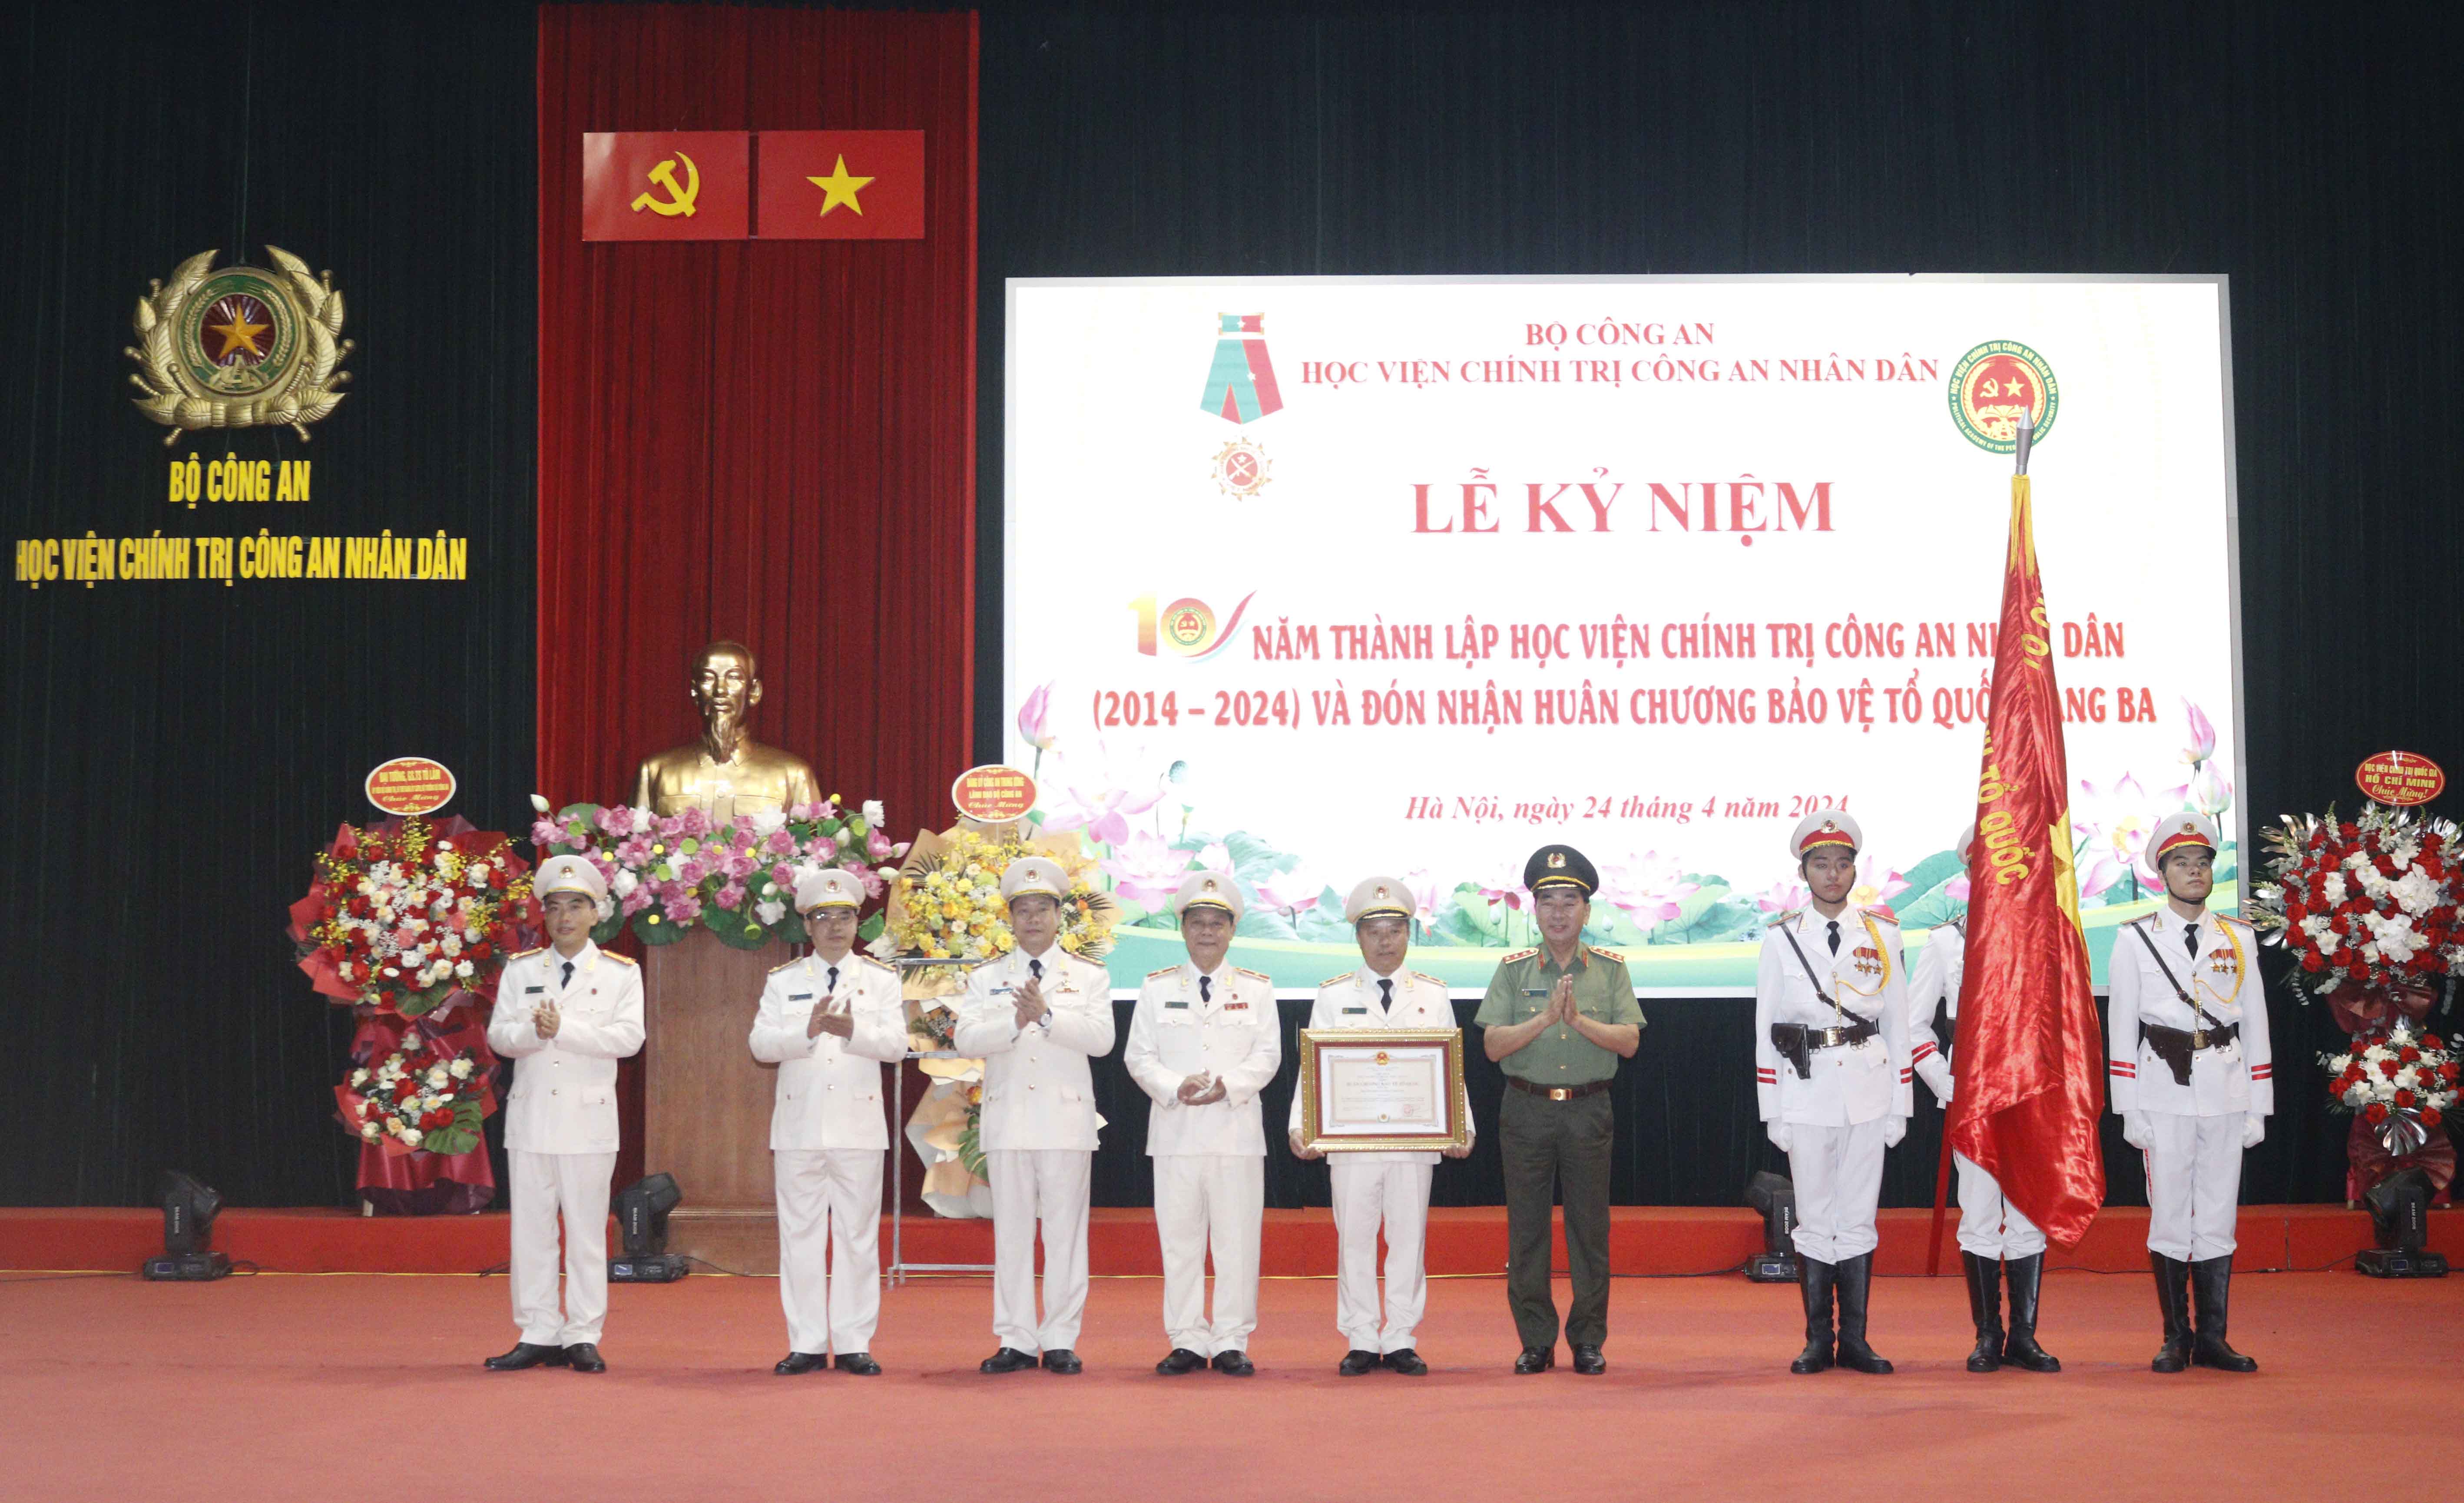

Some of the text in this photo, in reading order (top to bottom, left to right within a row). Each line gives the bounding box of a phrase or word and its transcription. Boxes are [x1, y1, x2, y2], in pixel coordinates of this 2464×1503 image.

[1526, 316, 1715, 352] BỘ CÔNG AN
[1302, 351, 1938, 390] HỌC VIỆN CHÍNH TRỊ CÔNG AN NHÂN DÂN
[2022, 349, 2034, 360] AN
[168, 451, 311, 509] BỘ CÔNG AN
[1409, 466, 1835, 548] LỄ KỶ NIỆM
[16, 528, 467, 589] HỌC VIỆN CHÍNH TRỊ CÔNG AN NHÂN DÂN
[1252, 616, 1321, 661] NĂM
[1328, 613, 1434, 661] THÀNH
[1445, 614, 1500, 670] LẬP
[1509, 623, 1570, 669] HỌC
[1578, 613, 1651, 669] VIỆN
[1660, 612, 1757, 660] CHÍNH
[1765, 622, 1815, 668] TRỊ
[1825, 612, 1905, 659] CÔNG
[1914, 622, 1956, 659] AN
[2062, 611, 2125, 659] DÂN
[1093, 689, 1179, 732] (2014
[1213, 687, 1301, 731] 2024)
[1311, 678, 1351, 727] VÀ
[1361, 679, 1426, 726] ĐÓN
[1436, 679, 1523, 735] NHẬN
[1533, 678, 1620, 726] HUÂN
[1630, 685, 1757, 726] CHƯƠNG
[1767, 675, 1828, 724] BẢO
[1836, 677, 1875, 734] VỆ
[1882, 668, 1923, 724] TỔ
[1932, 668, 1991, 730] QUỐ
[2116, 686, 2158, 724] BA
[2372, 785, 2395, 795] Chúc
[2384, 775, 2403, 786] CHÍ
[2406, 778, 2436, 788] MINH
[1404, 795, 1444, 820] Hà
[1451, 795, 1505, 825] Nội,
[1513, 796, 1575, 826] ngày
[1582, 795, 1613, 819] 24
[1620, 795, 1694, 825] tháng
[1701, 795, 1716, 819] 4
[1724, 796, 1780, 819] năm
